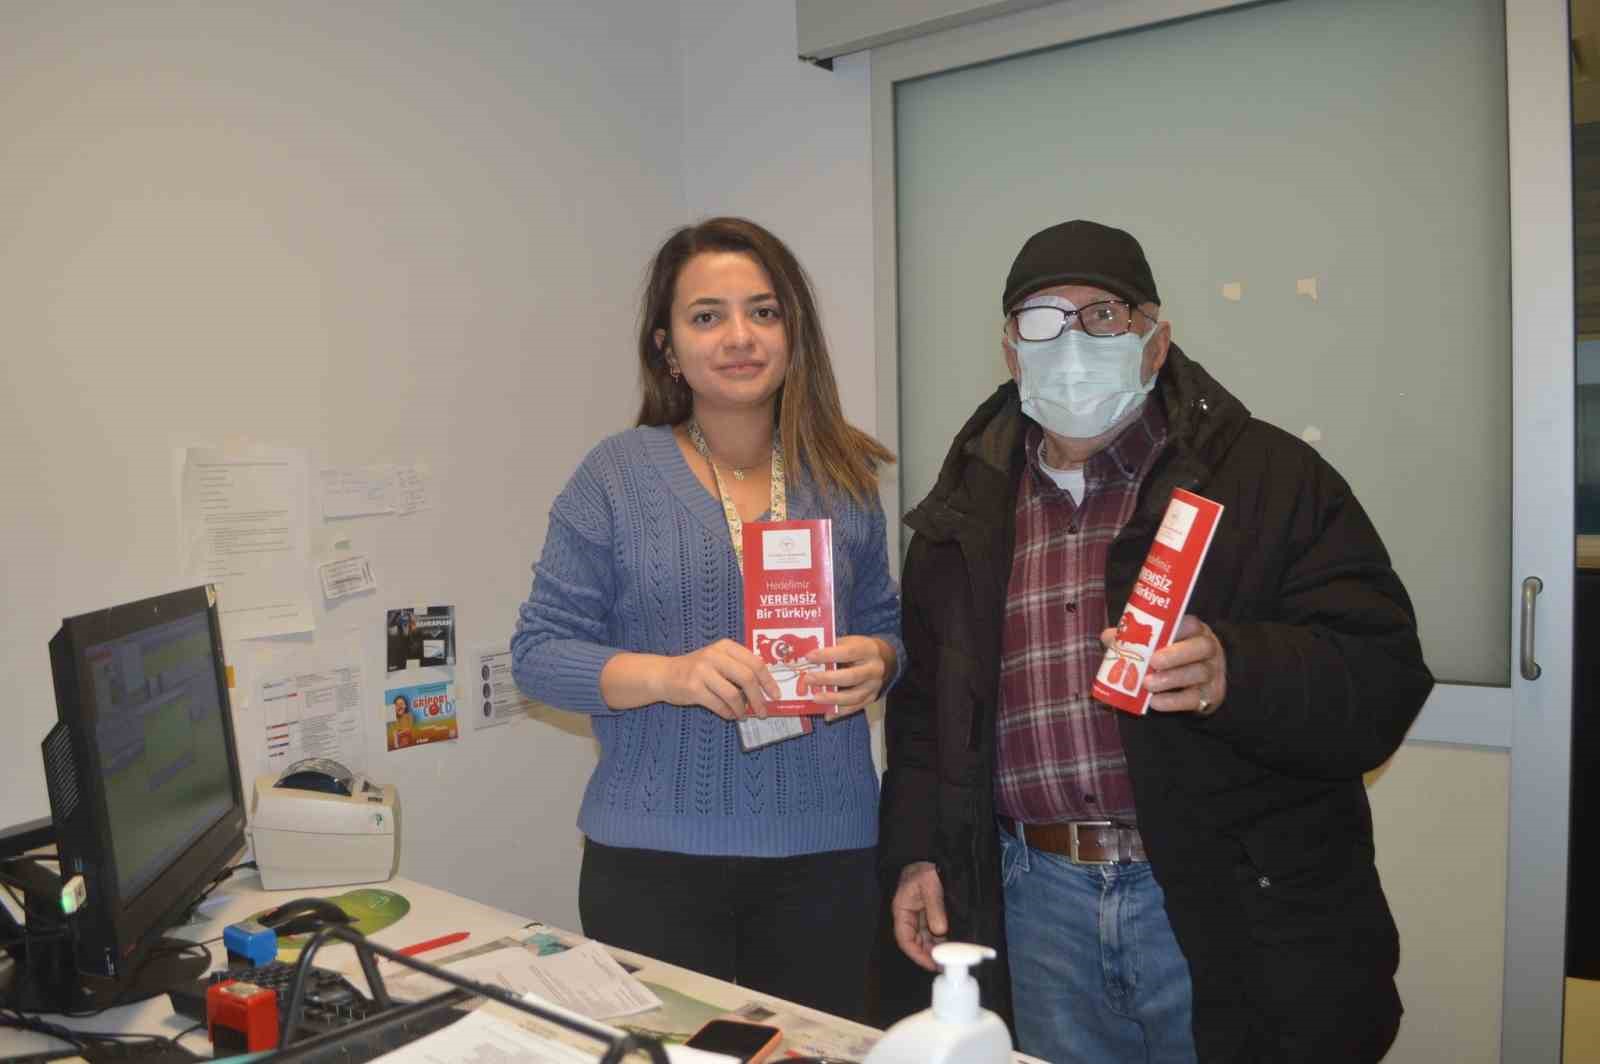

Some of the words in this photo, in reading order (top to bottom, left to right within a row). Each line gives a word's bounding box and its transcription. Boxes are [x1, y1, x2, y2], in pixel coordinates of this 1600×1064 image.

[766, 580, 809, 591] Hedefimiz
[760, 591, 817, 605] VEREMSİZ
[756, 608, 773, 619] Bir
[775, 607, 821, 619] Türkiye!
